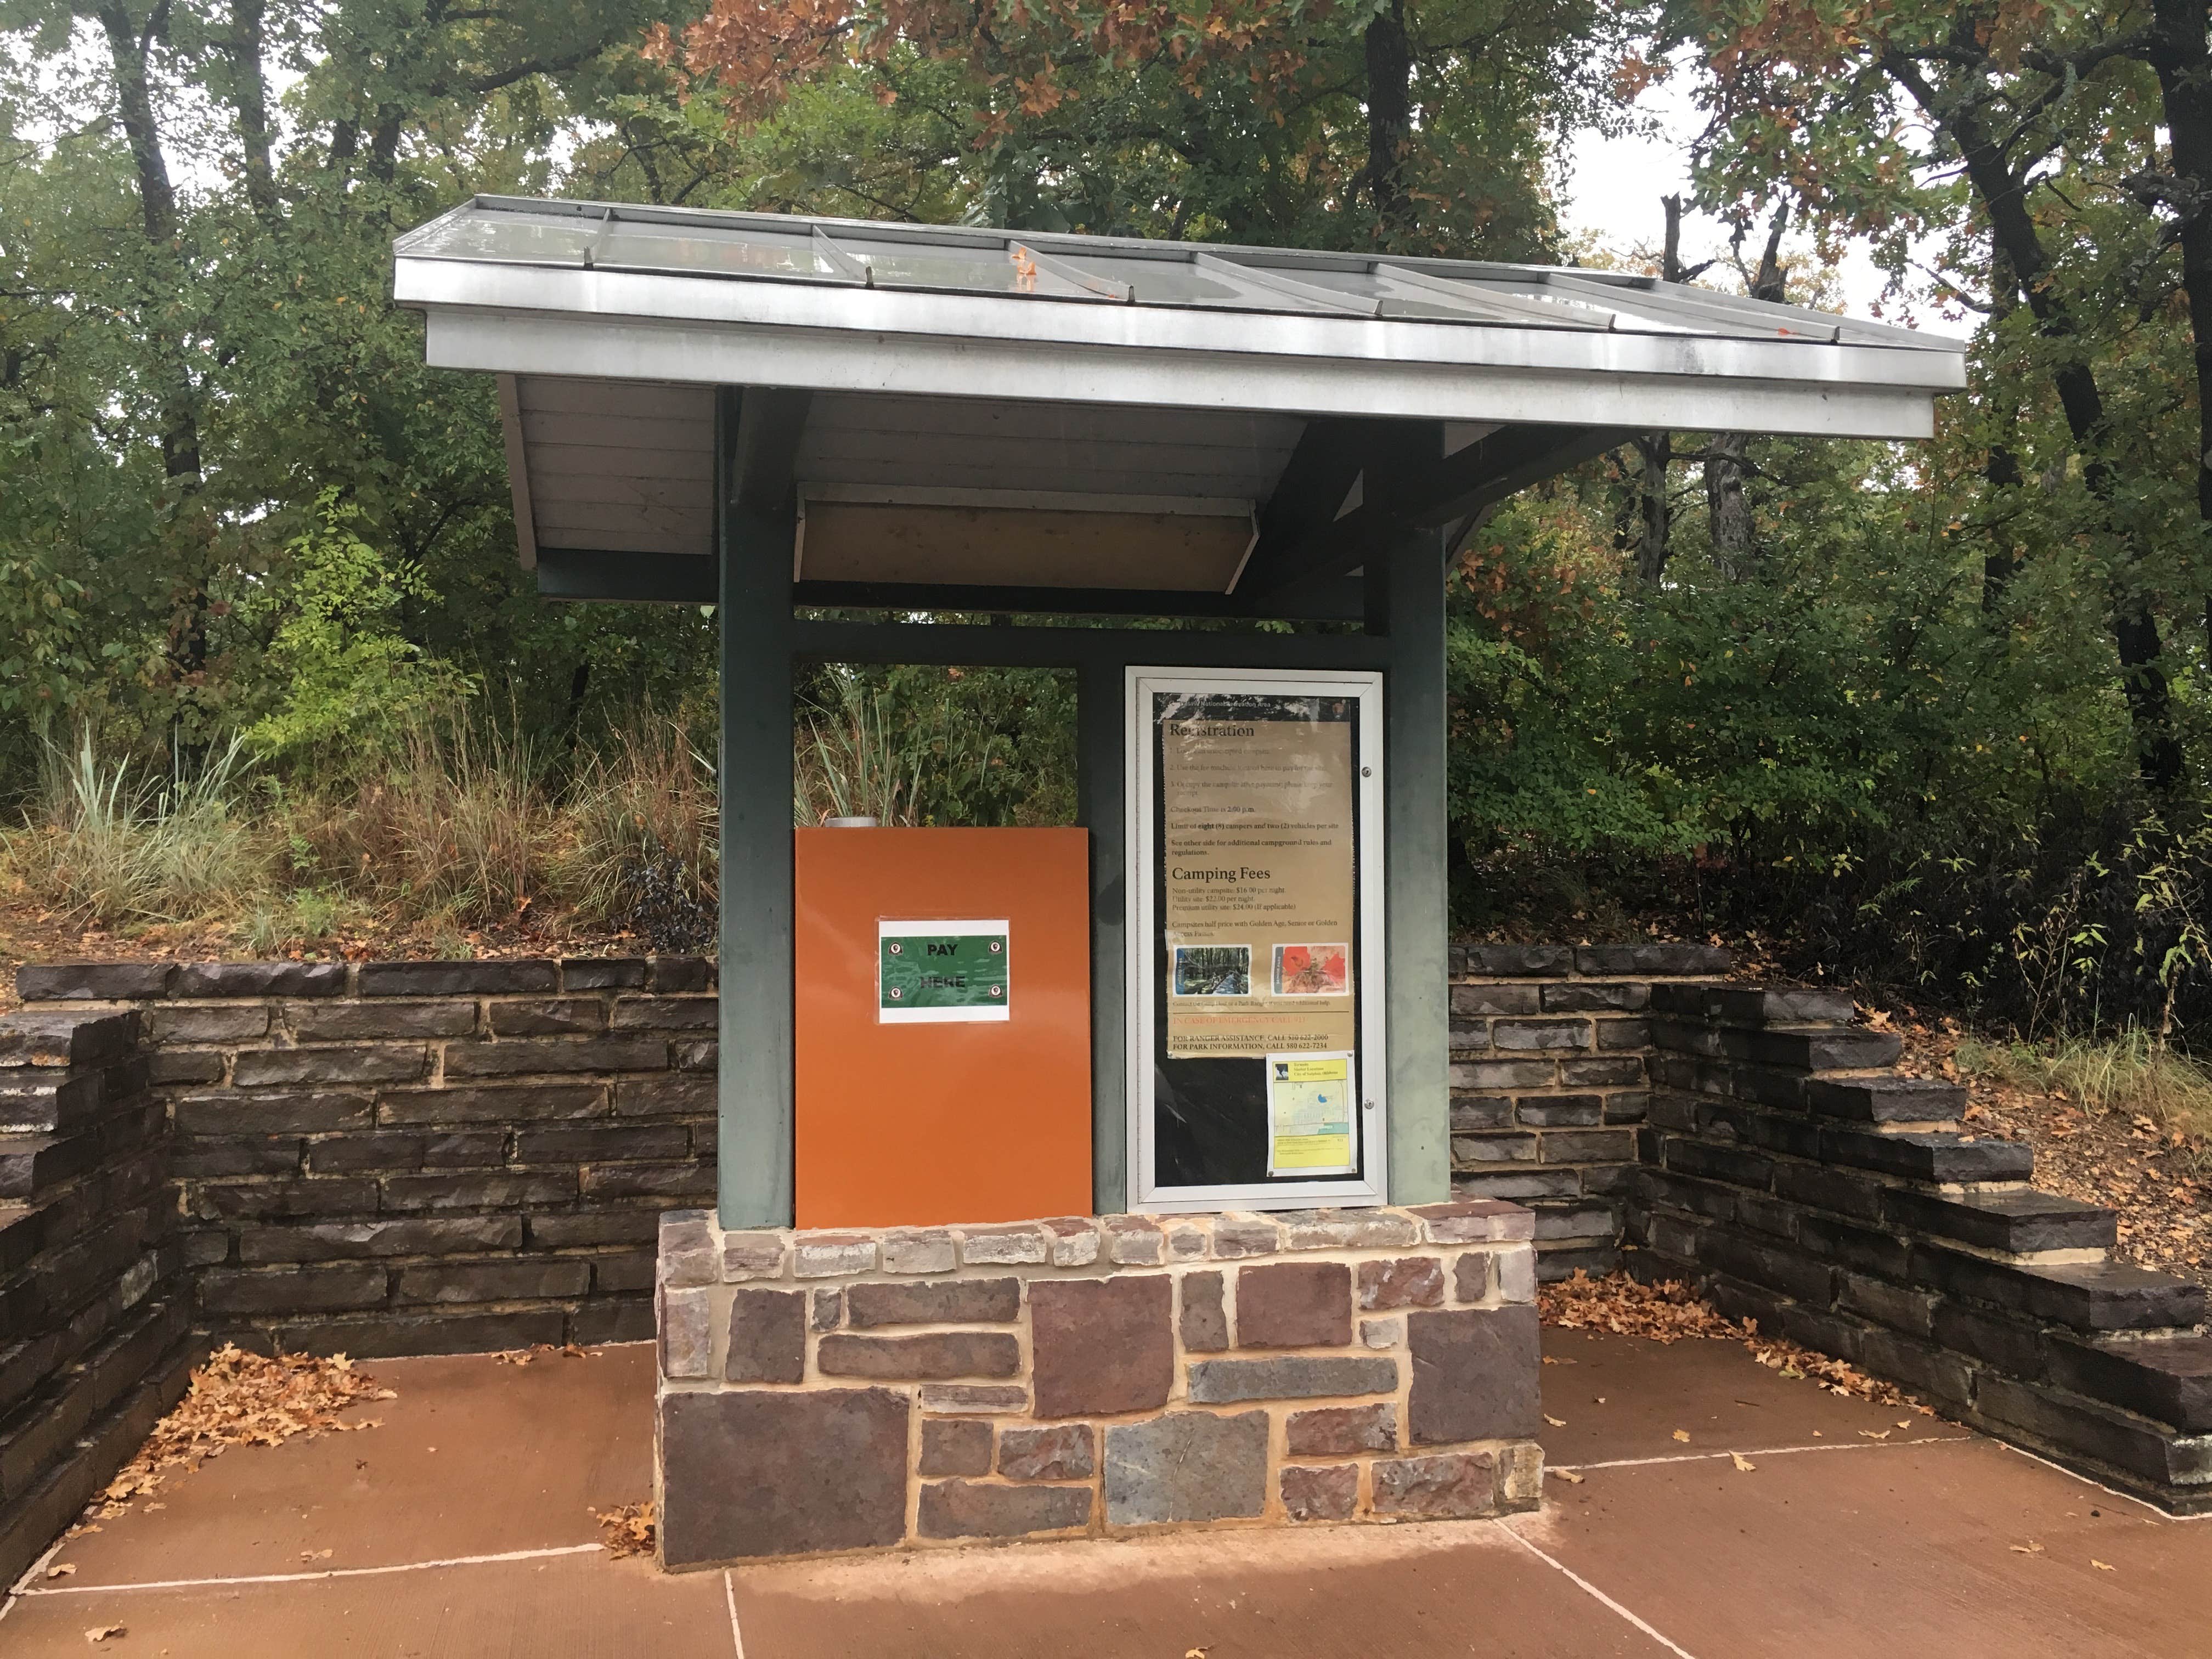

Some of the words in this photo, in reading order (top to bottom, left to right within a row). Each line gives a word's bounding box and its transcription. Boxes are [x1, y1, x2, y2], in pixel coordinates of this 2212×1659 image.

[1170, 723, 1255, 738] Reistration
[1172, 867, 1236, 883] Camping
[1240, 867, 1271, 879] Fees
[927, 944, 958, 956] PAY
[920, 976, 966, 988] HERE
